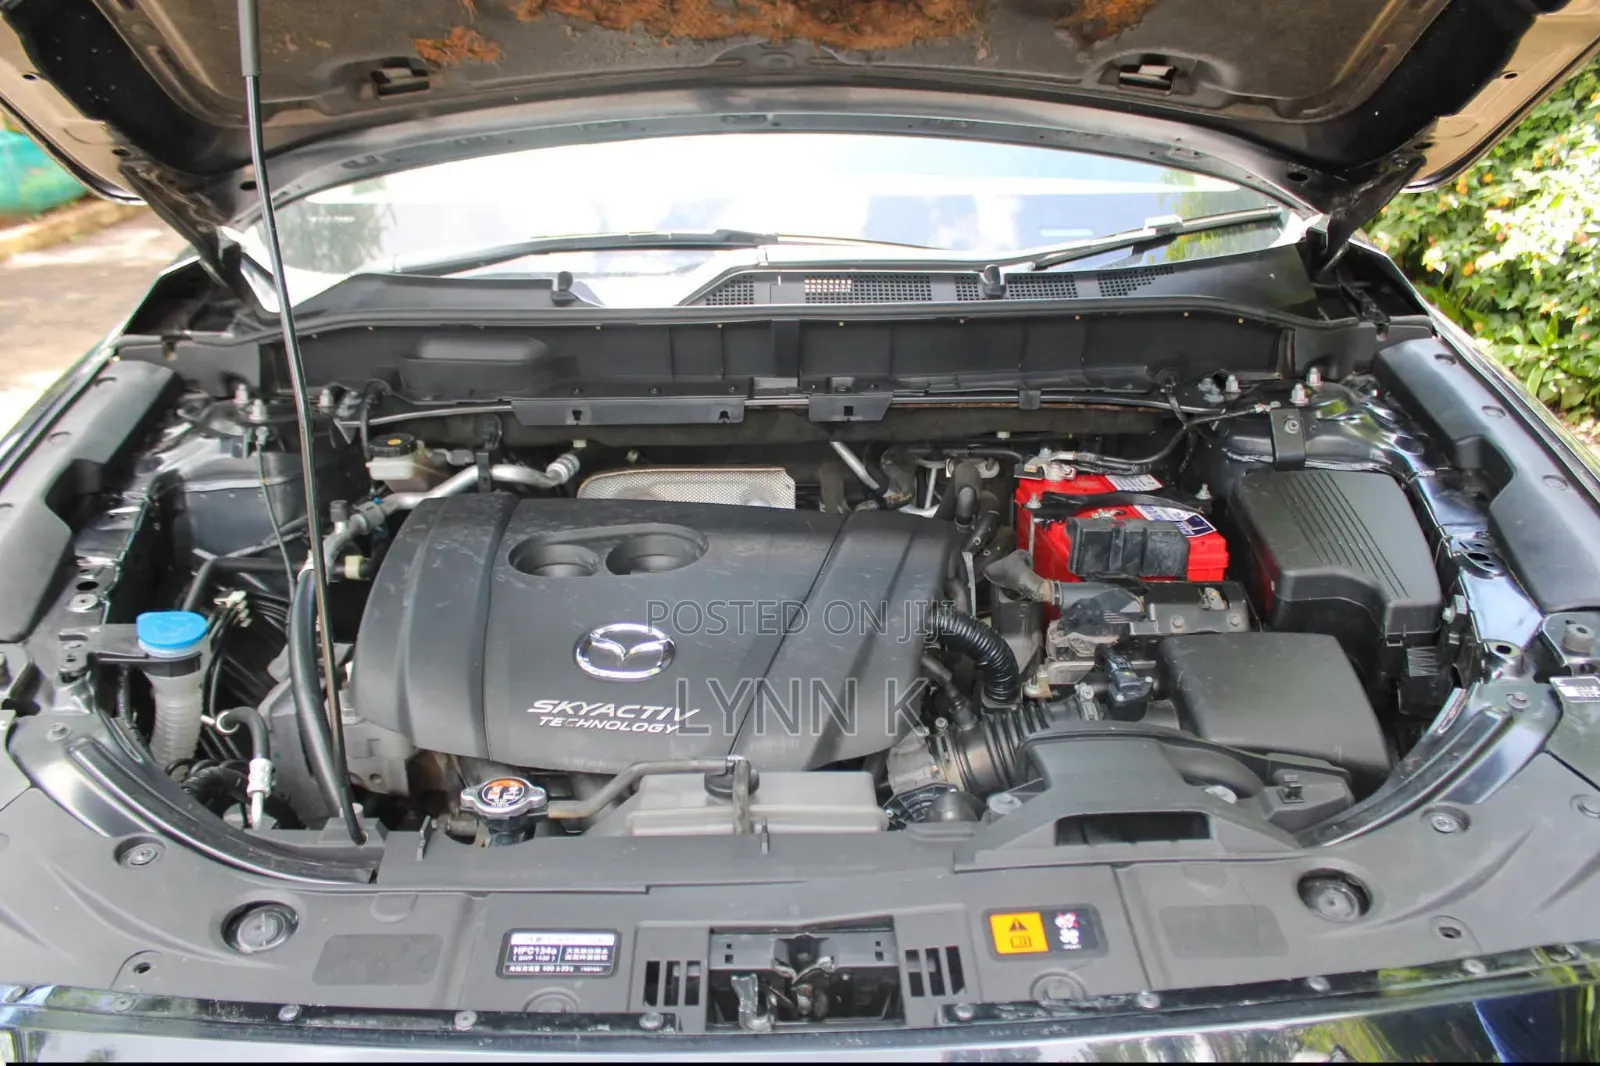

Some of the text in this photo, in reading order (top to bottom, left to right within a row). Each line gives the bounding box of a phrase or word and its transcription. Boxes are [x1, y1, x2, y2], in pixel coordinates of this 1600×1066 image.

[527, 700, 700, 722] SKYACTIV
[539, 716, 681, 735] TECHNOLOGY
[513, 946, 557, 955] HFC134a
